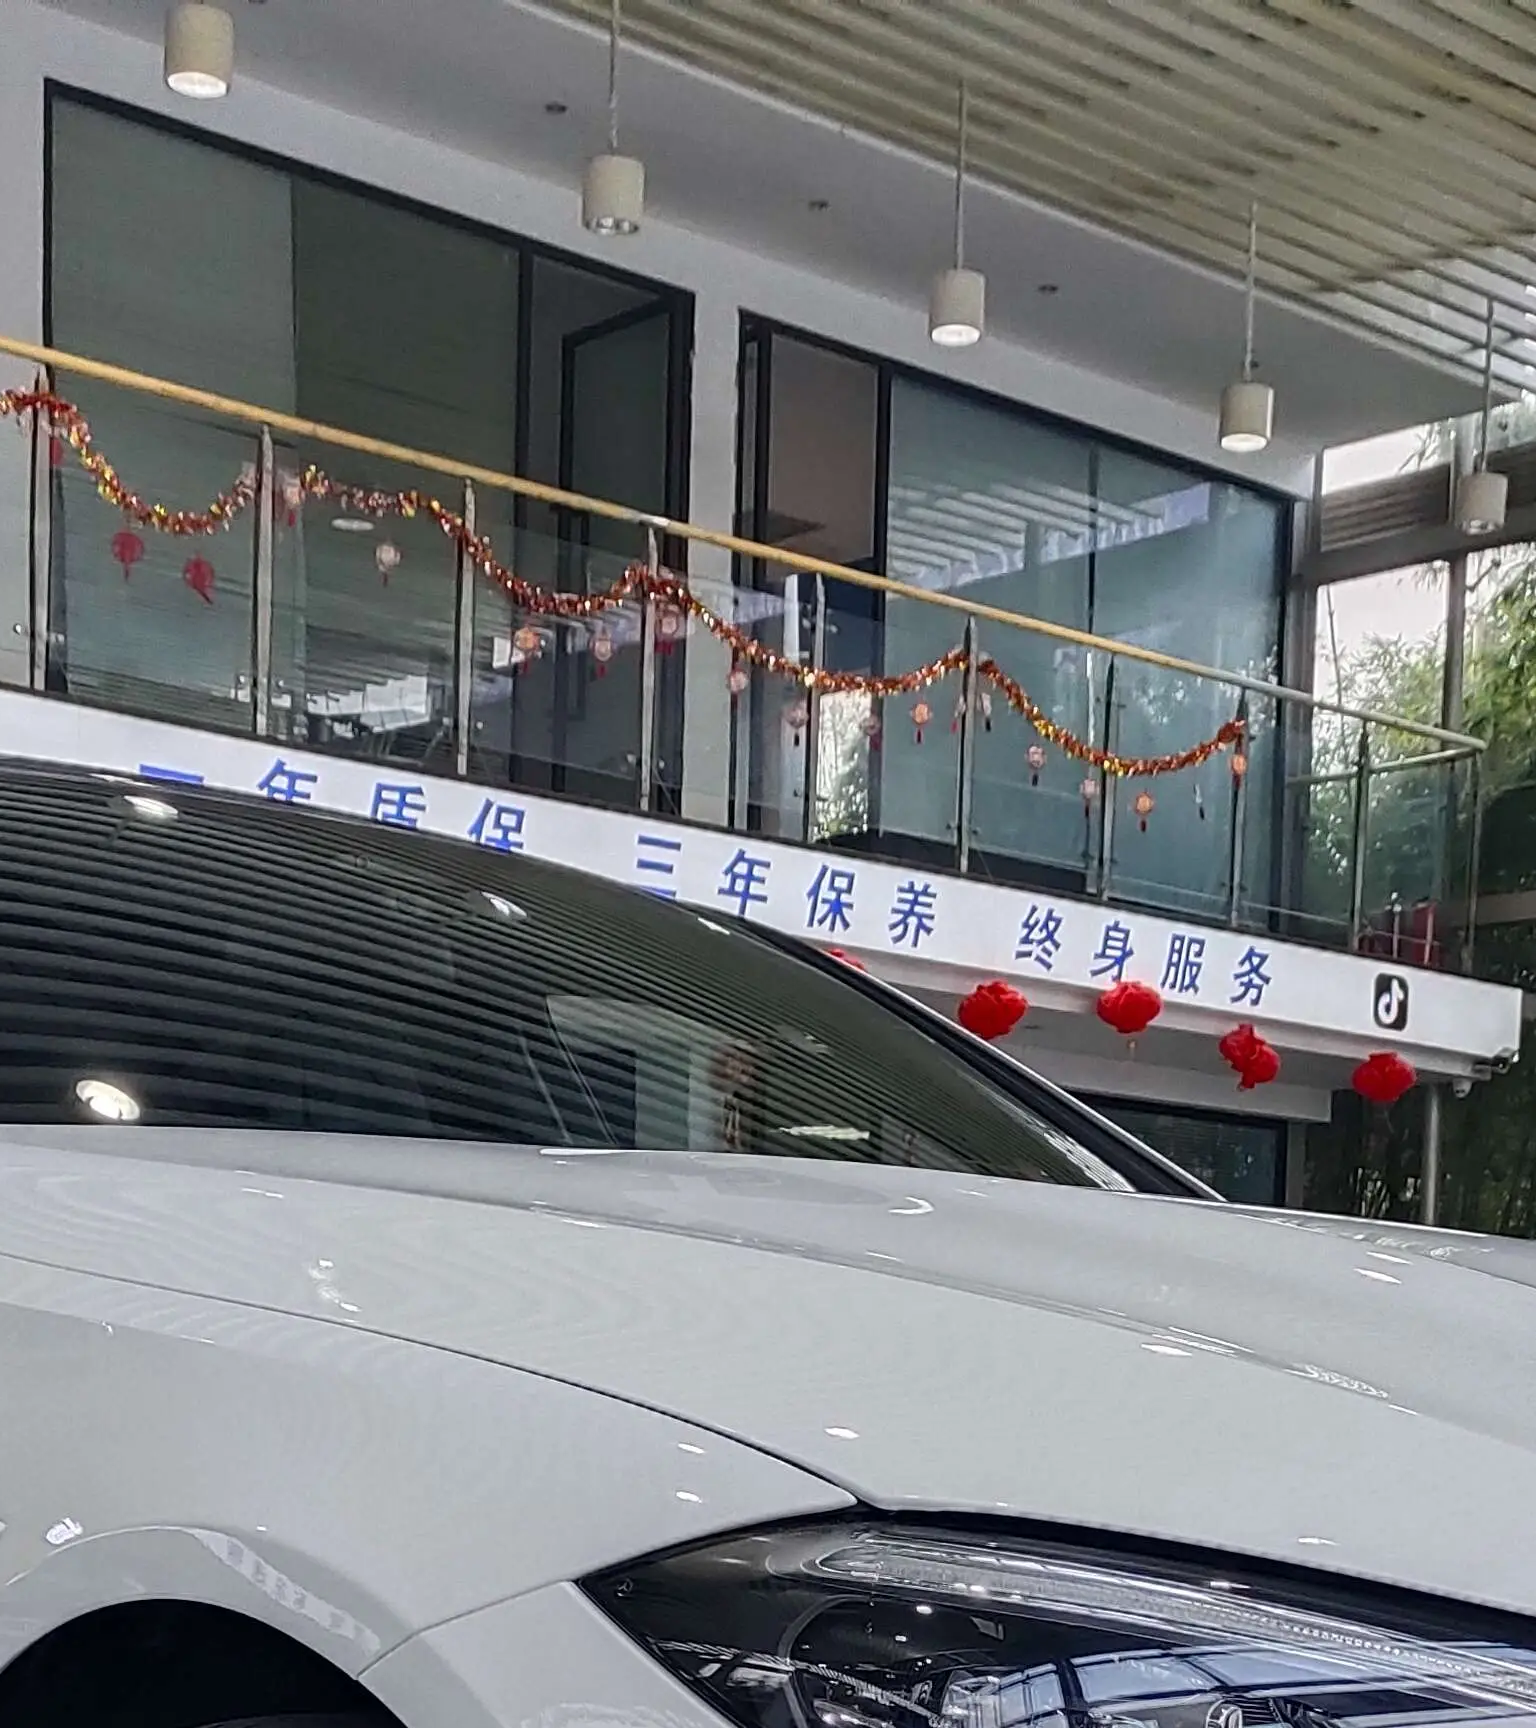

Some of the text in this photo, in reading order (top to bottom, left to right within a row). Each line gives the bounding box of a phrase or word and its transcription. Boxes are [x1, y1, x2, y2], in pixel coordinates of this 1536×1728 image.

[636, 834, 938, 949] 三年保养
[1015, 904, 1274, 1008] 终身服务
